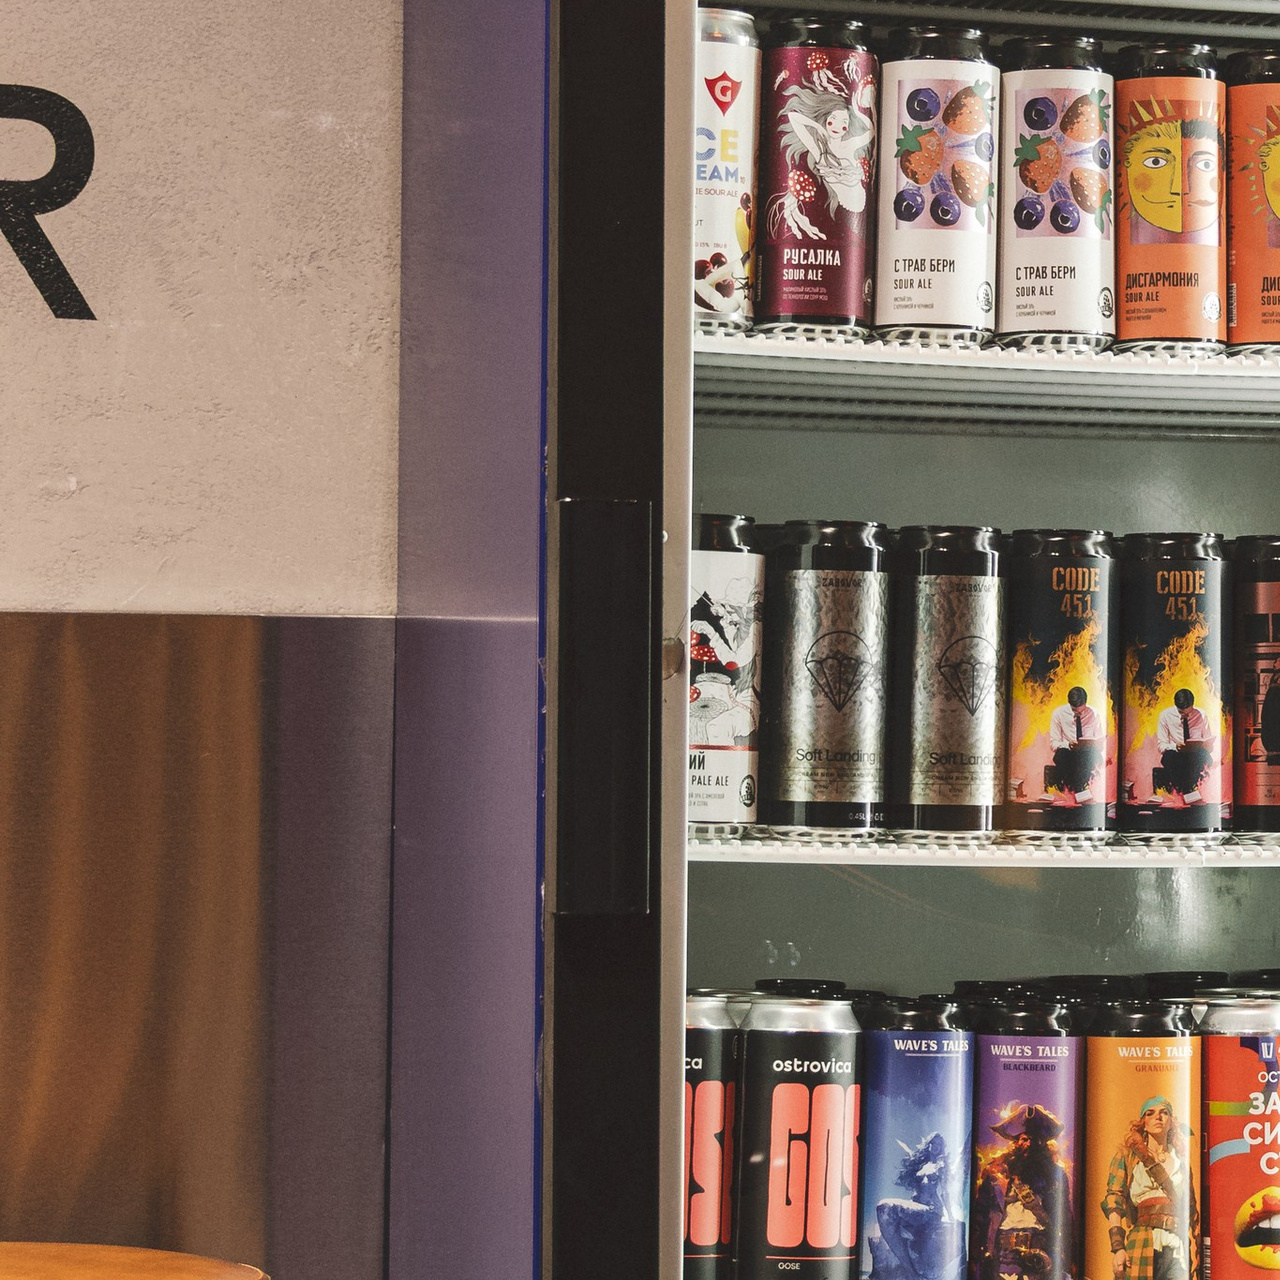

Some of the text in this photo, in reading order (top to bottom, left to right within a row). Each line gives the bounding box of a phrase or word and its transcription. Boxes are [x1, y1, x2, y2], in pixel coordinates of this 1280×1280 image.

[783, 248, 841, 267] РУСАЛКА
[902, 258, 956, 273] ТРАВ БЕРИ
[1023, 265, 1076, 280] ТРАВ БЕРИ
[783, 269, 823, 281] SOUR ALE
[1125, 272, 1199, 291] ДИСГАРМОНИЯ
[893, 278, 932, 289] SOUR ALE
[1015, 285, 1054, 297] SOUR ALE
[1125, 291, 1160, 303] SOUR ALE
[1052, 567, 1100, 592] CODE
[1156, 569, 1206, 595] CODE
[1061, 594, 1093, 618] 451
[1166, 597, 1198, 620] 451
[796, 749, 876, 765] Soft Landing
[930, 752, 956, 766] Soft
[691, 776, 729, 787] PALE ALE
[894, 1039, 969, 1053] WAVE'S TALES
[990, 1044, 1070, 1058] WAVE'S TALES
[1117, 1045, 1193, 1059] WAVE'S TALES
[773, 1057, 852, 1073] ostrovica
[1003, 1062, 1057, 1073] BLACKBEARD
